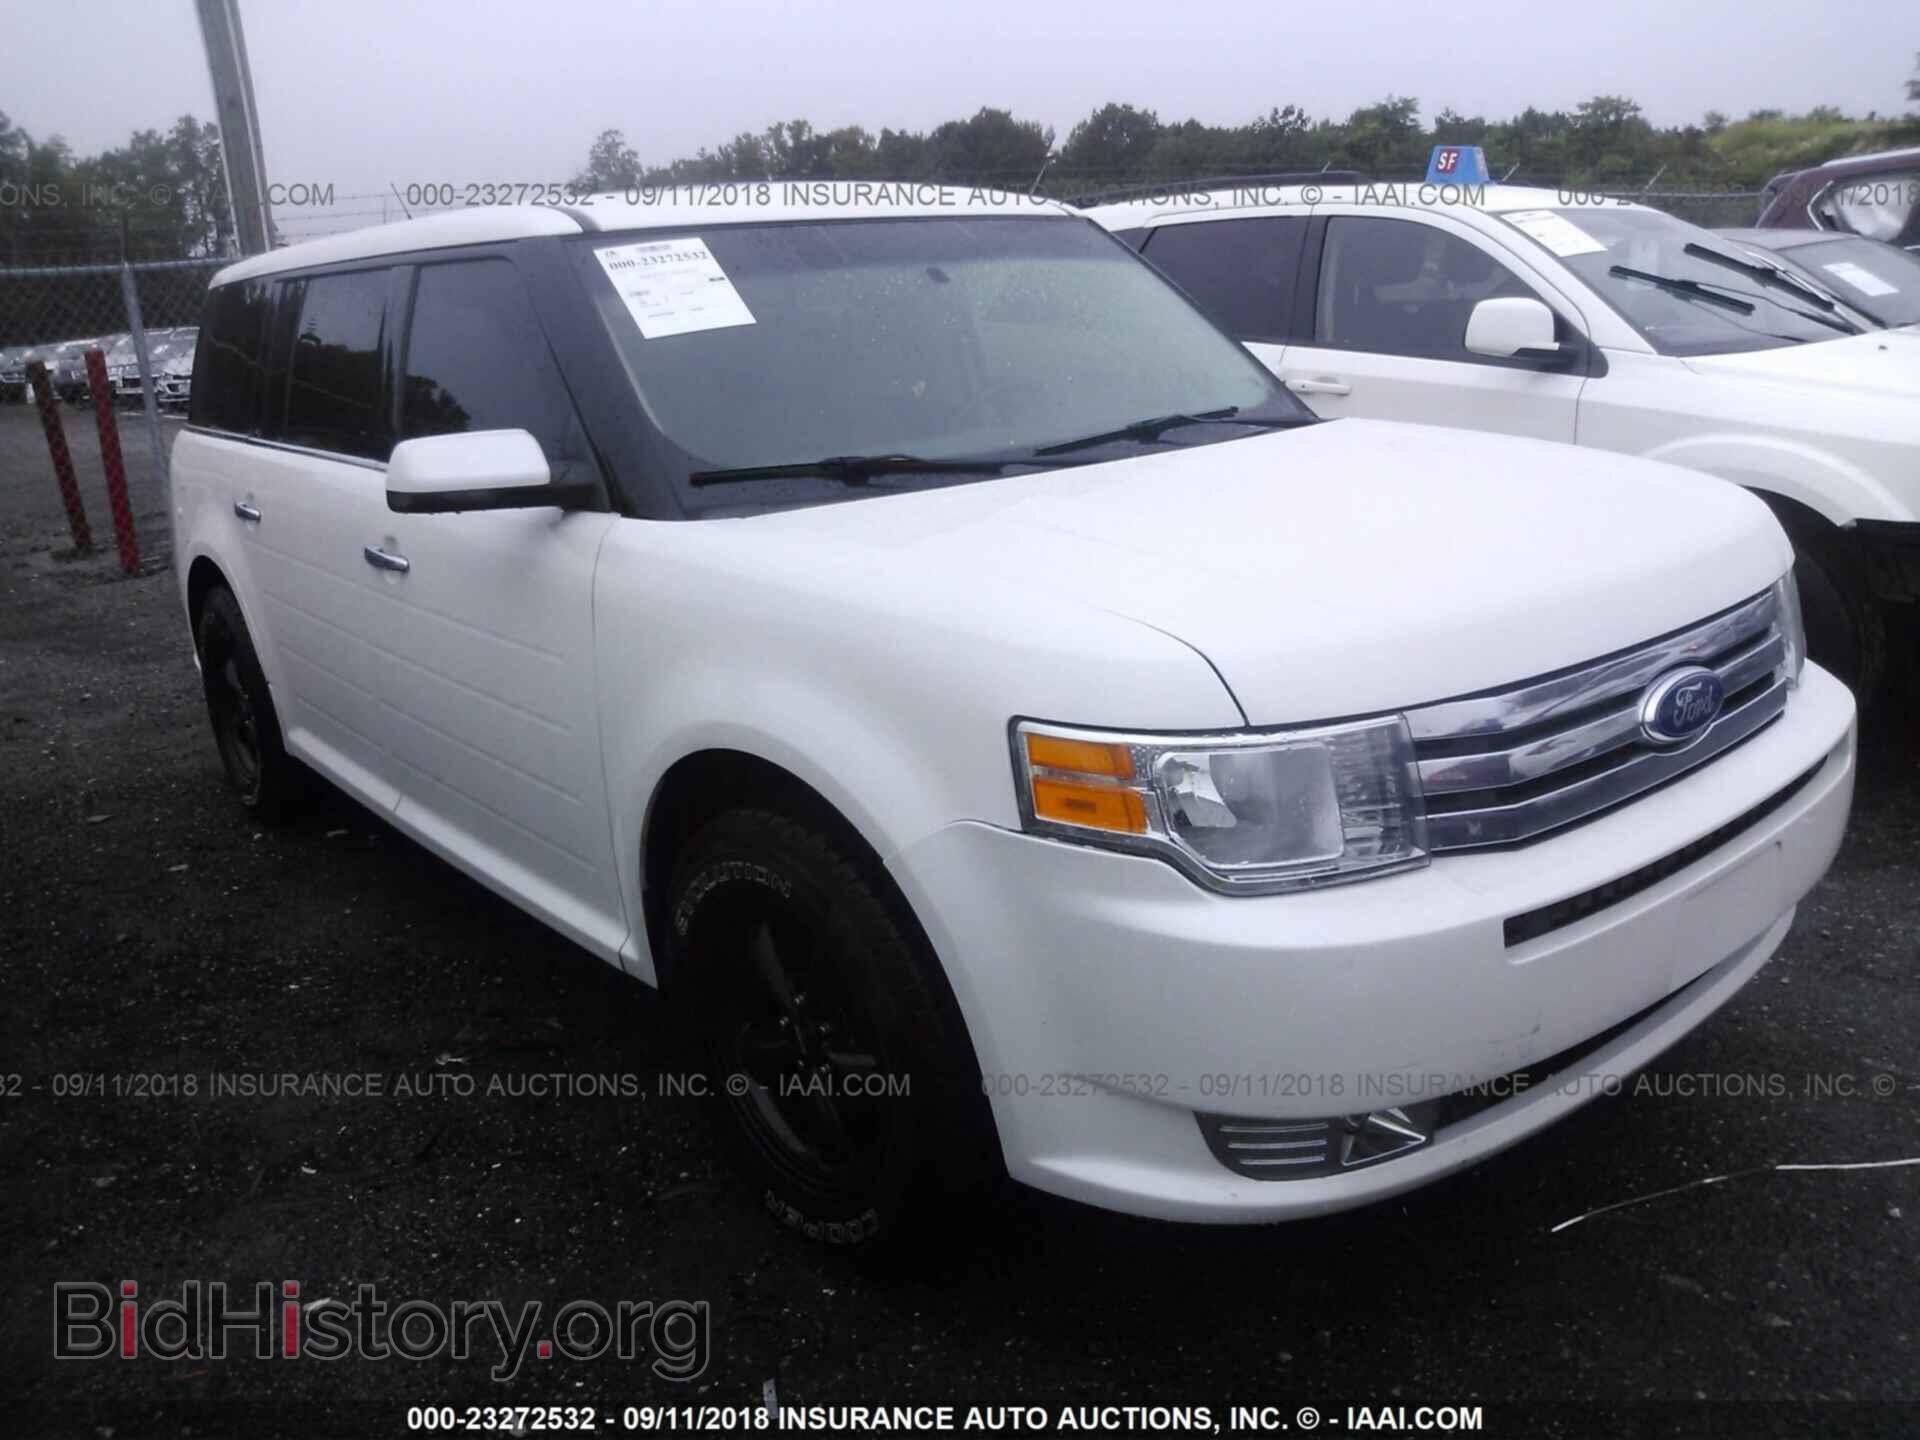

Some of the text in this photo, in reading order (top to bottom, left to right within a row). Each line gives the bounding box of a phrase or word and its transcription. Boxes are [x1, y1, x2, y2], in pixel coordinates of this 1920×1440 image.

[1437, 151, 1458, 171] SF
[608, 250, 708, 271] 000-23272532
[1673, 680, 1714, 728] Ford
